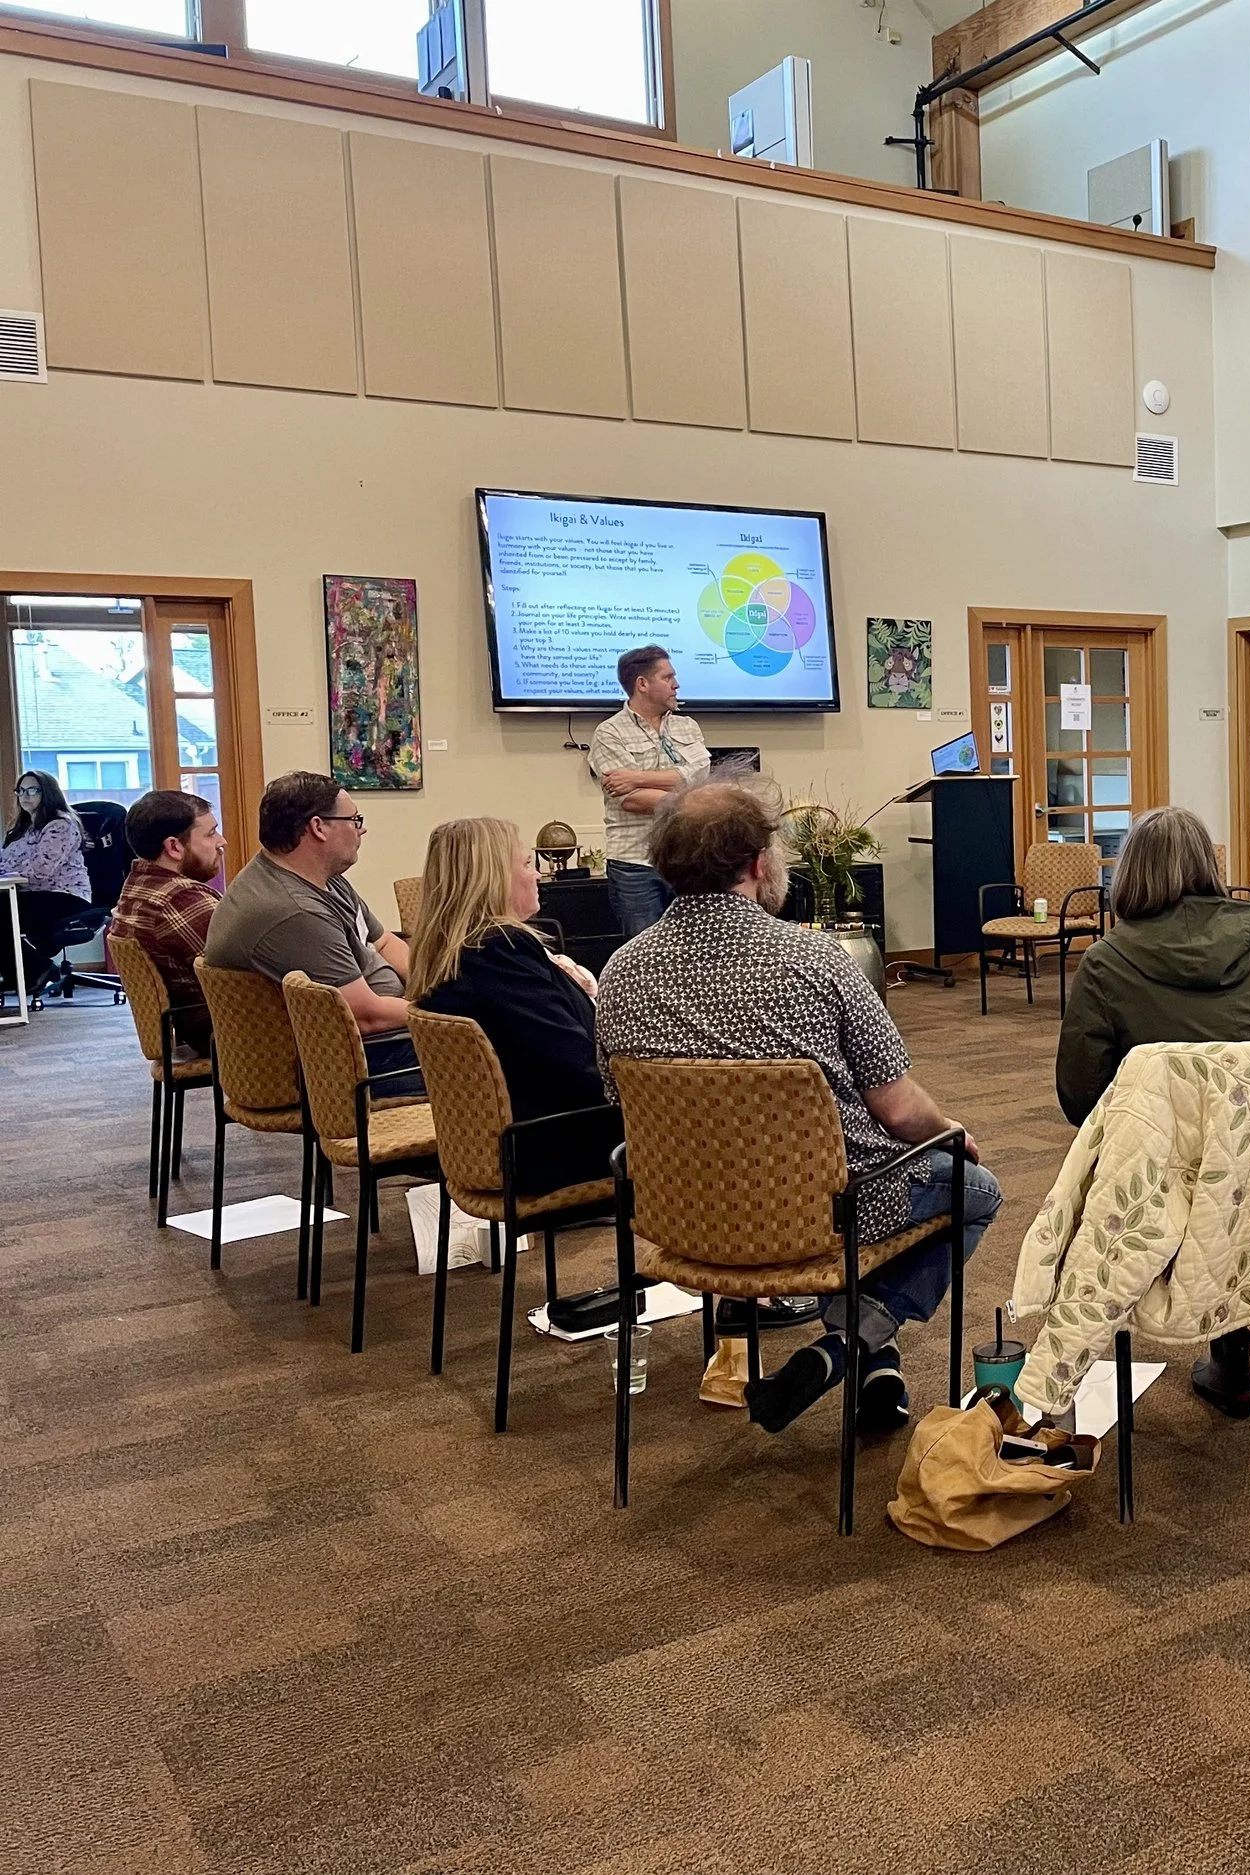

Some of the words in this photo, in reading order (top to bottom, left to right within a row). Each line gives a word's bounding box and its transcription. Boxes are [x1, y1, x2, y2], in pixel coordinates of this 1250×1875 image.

[550, 512, 576, 527] Ikigai
[580, 514, 588, 525] &
[590, 514, 624, 527] Values
[740, 534, 762, 544] Ikigai
[749, 610, 767, 619] Ikigai
